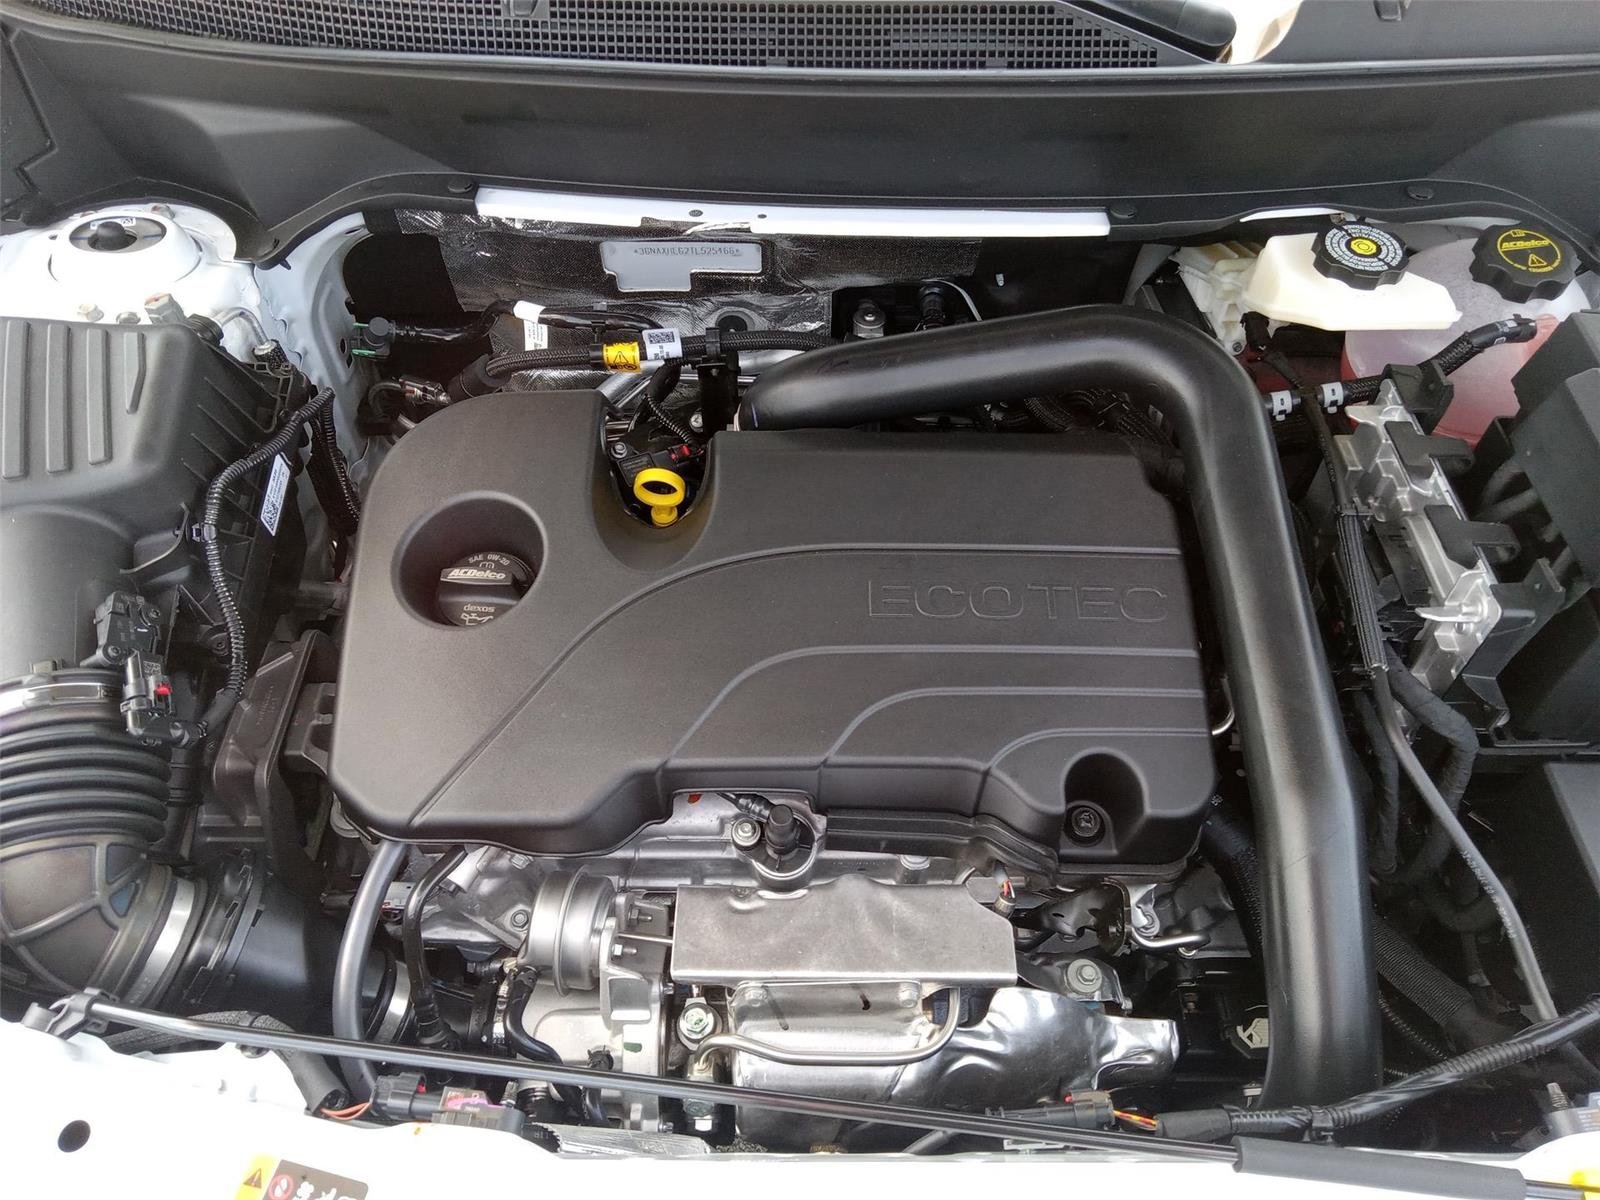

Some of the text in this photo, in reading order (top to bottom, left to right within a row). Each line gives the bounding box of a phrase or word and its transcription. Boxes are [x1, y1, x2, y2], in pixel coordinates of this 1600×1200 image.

[468, 553, 510, 566] SAE 0W-20
[447, 568, 506, 579] ACDelco
[867, 580, 1169, 623] ECOTEC
[463, 603, 495, 613] dexos
